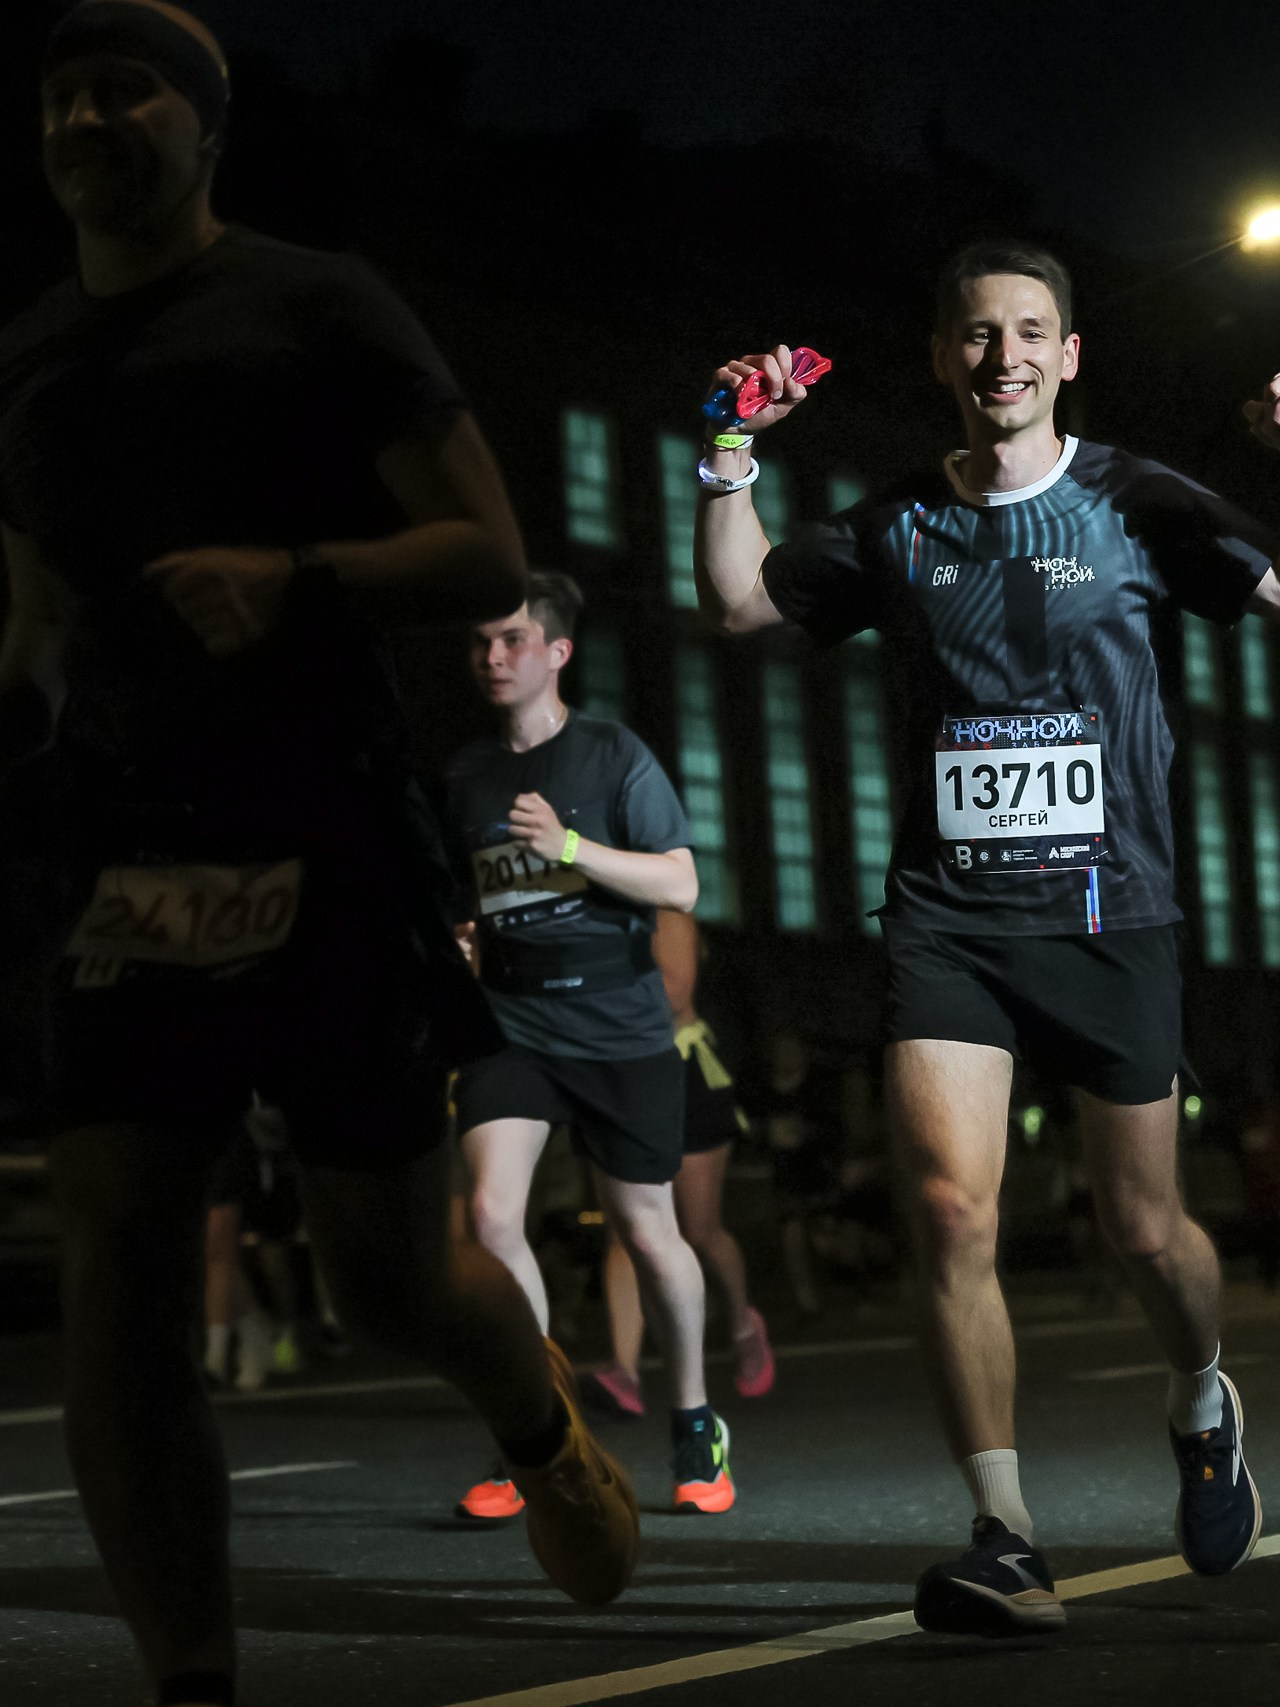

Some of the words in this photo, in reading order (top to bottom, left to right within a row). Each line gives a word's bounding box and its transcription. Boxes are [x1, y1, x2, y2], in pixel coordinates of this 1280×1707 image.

[953, 713, 1081, 743] НОЧНОЙ
[945, 759, 1095, 811] 13710
[988, 809, 1048, 827] СЕРГЕЙ
